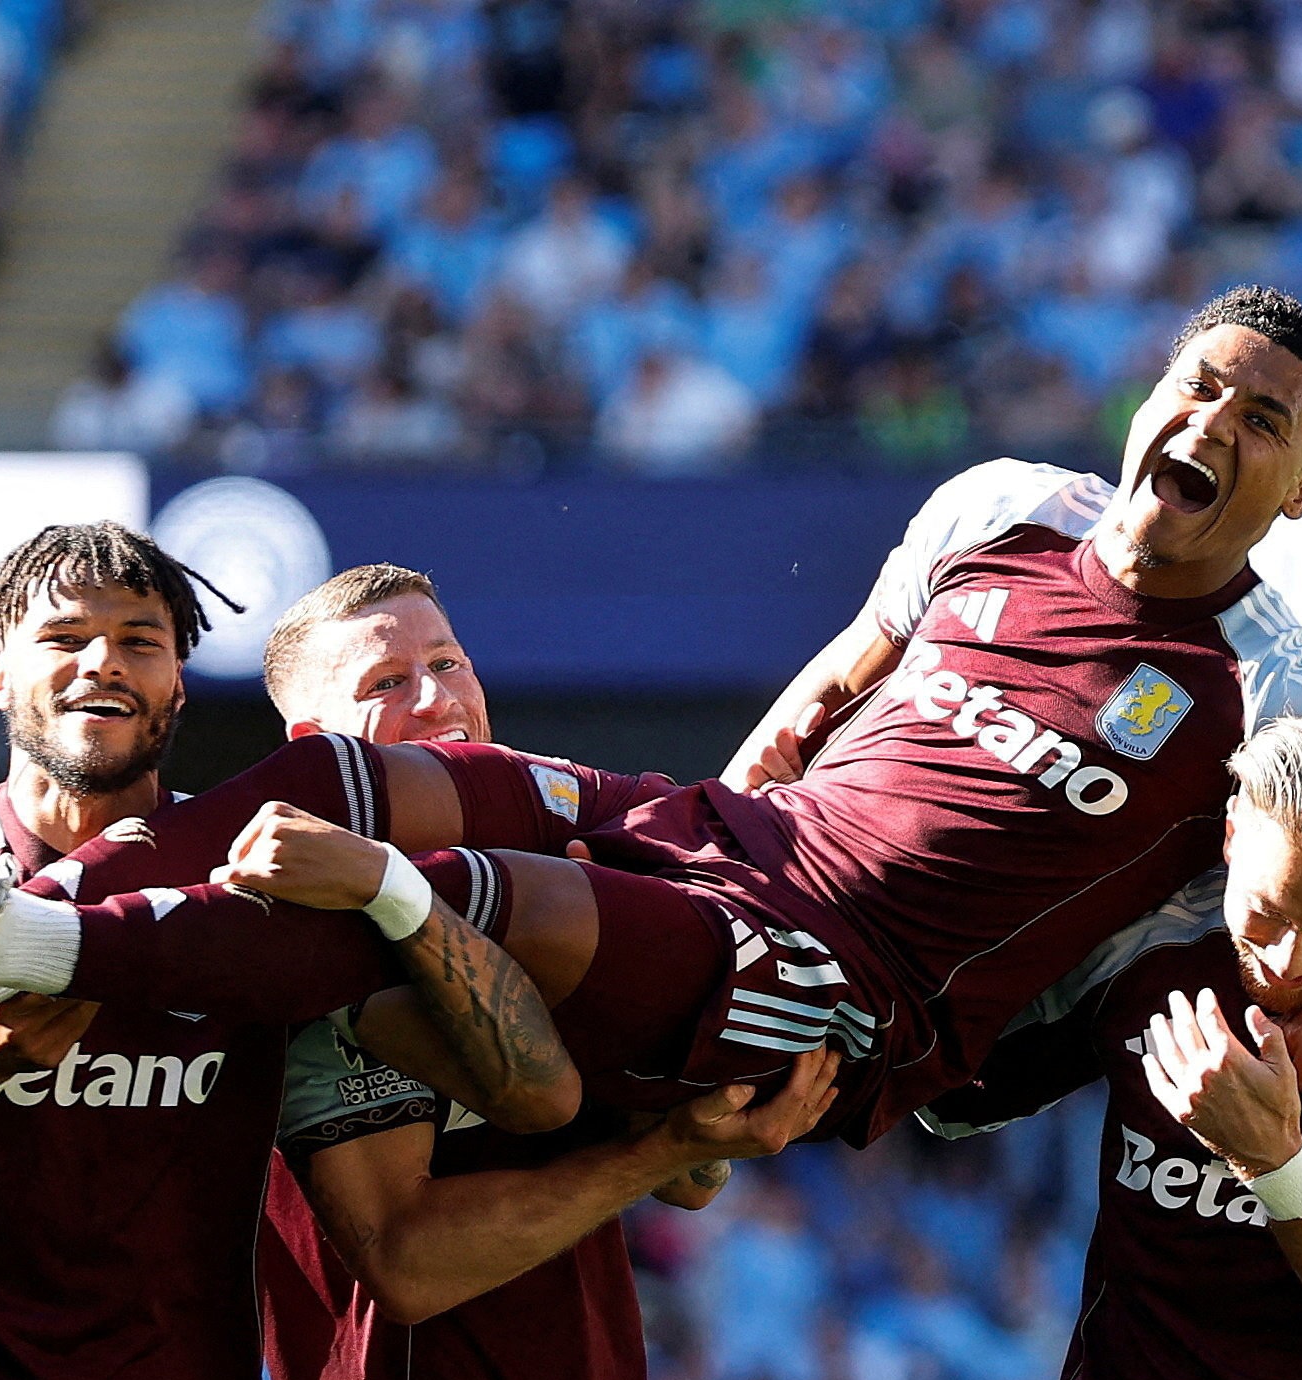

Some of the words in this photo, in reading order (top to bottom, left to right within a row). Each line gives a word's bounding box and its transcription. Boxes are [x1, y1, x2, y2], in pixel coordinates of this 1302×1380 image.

[887, 636, 1128, 815] Betano
[1123, 741, 1148, 754] VILLA
[3, 1041, 226, 1107] etano
[337, 1076, 365, 1096] No
[367, 1068, 407, 1086] roo
[370, 1079, 424, 1099] racism
